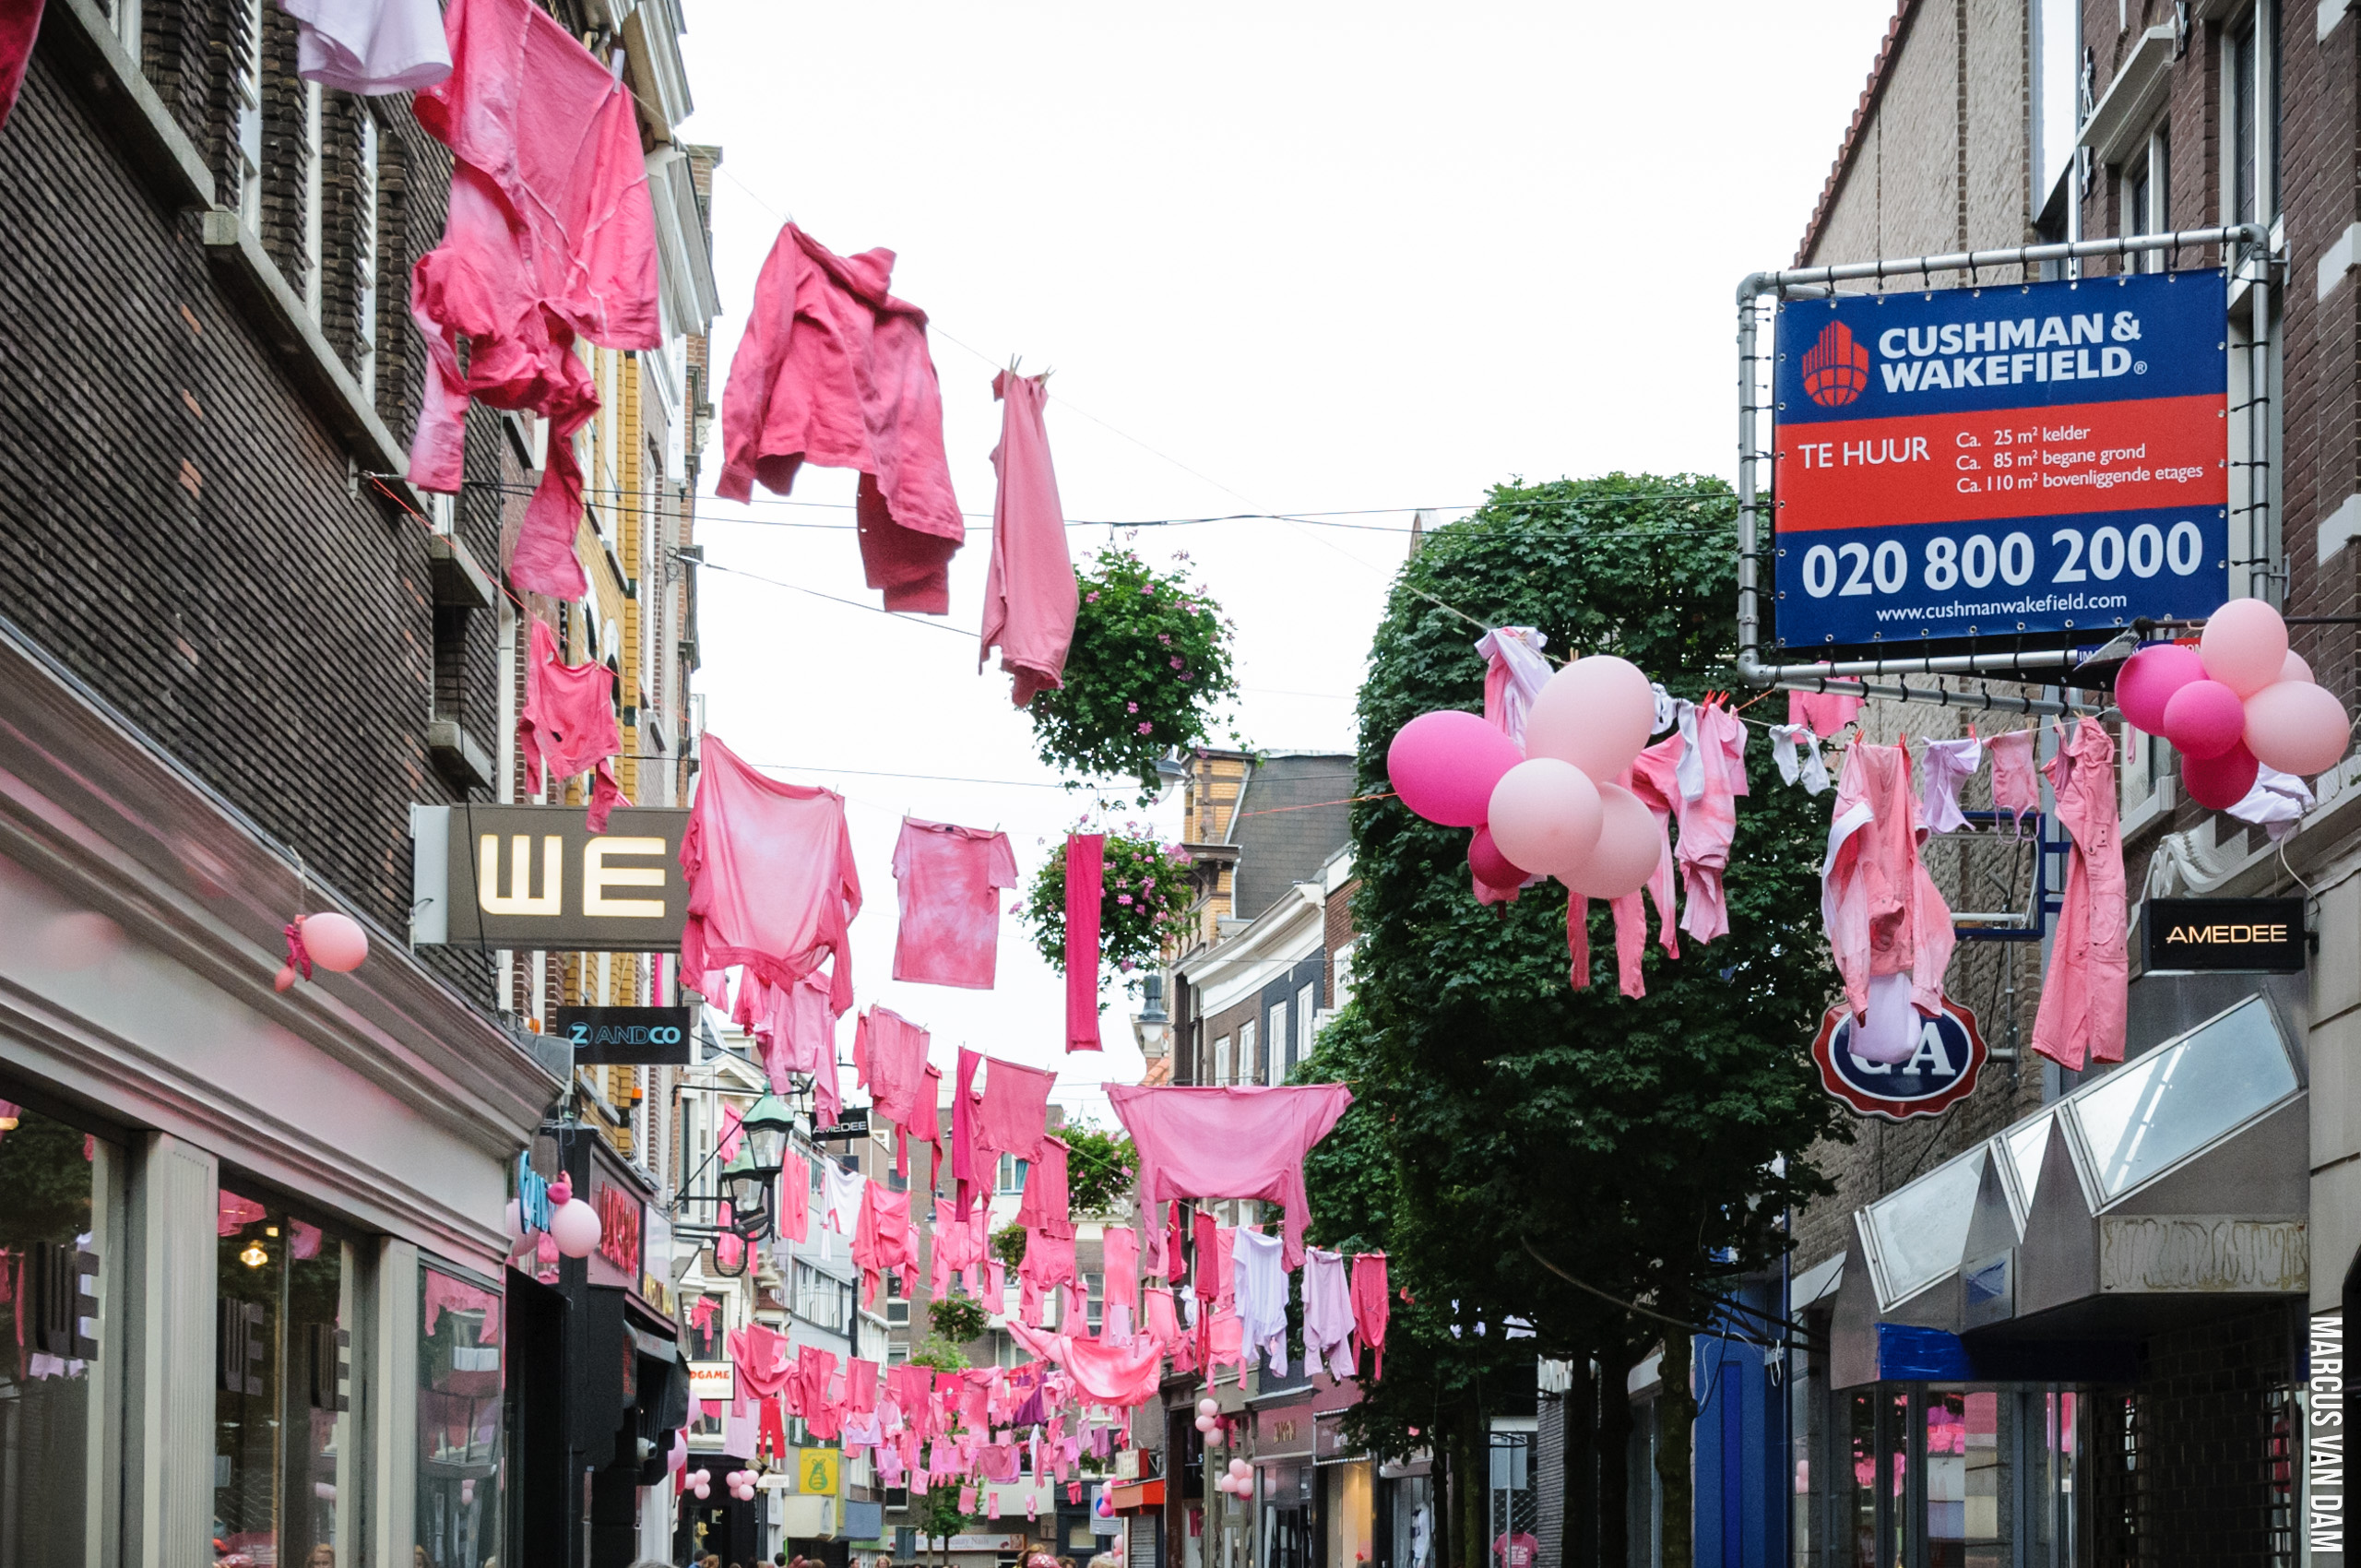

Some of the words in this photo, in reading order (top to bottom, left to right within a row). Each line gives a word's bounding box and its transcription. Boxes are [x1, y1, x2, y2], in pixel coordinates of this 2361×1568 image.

[1879, 313, 2104, 359] CUSHMAN
[2111, 311, 2142, 342] &
[1956, 432, 1982, 448] Ca.
[1993, 429, 2013, 445] 25
[2042, 424, 2091, 443] kelder
[1797, 443, 1833, 469] TE
[1843, 436, 1930, 466] HUUR
[1956, 455, 1982, 471] Ca.
[1993, 452, 2013, 468] 85
[2042, 450, 2096, 468] begane
[2099, 443, 2146, 465] grond
[1956, 477, 1982, 493] Ca.
[1987, 474, 2014, 492] 110
[2042, 466, 2151, 489] bovenliggende
[2154, 466, 2203, 483] etages
[1802, 540, 1908, 599] 020
[1923, 531, 2035, 591] 800
[2051, 521, 2202, 584] 2000
[1876, 593, 2127, 623] www.cushmanwakefield.com
[479, 834, 666, 918] WE
[2165, 925, 2287, 944] AMEDEE
[947, 1538, 969, 1547] eauty
